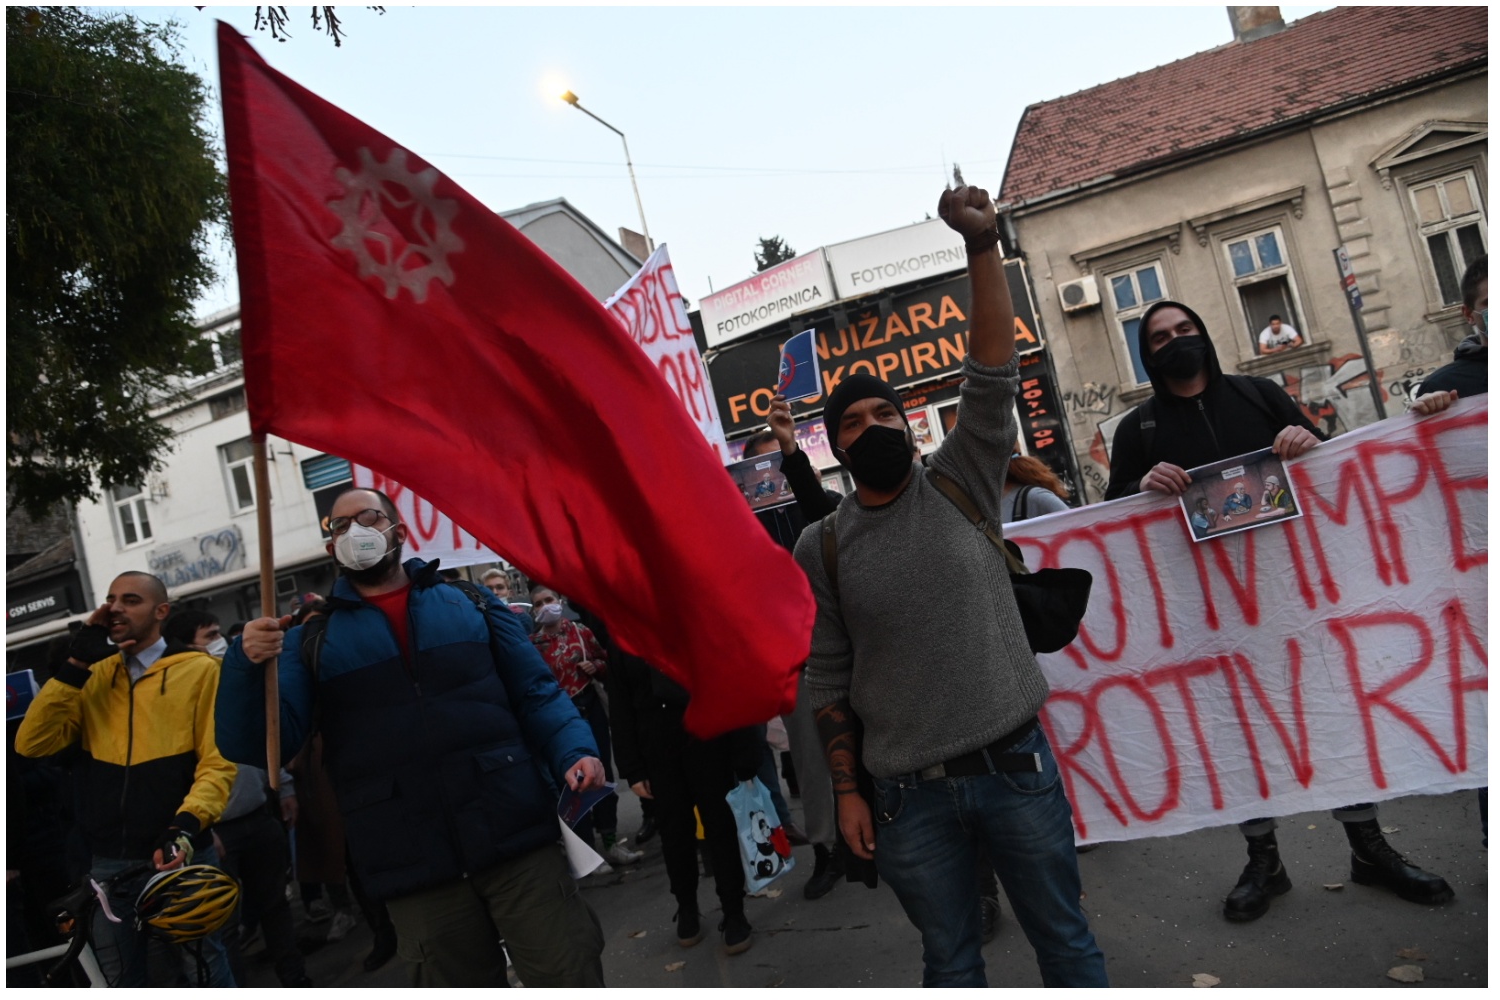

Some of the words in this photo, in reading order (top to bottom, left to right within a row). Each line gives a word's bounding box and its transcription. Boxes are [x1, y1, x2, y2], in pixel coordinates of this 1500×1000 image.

[713, 283, 759, 310] DIGITAL
[761, 260, 813, 291] CORNER
[716, 285, 823, 336] FOTOKOPIRNICA
[779, 294, 967, 361] NJIŽARA
